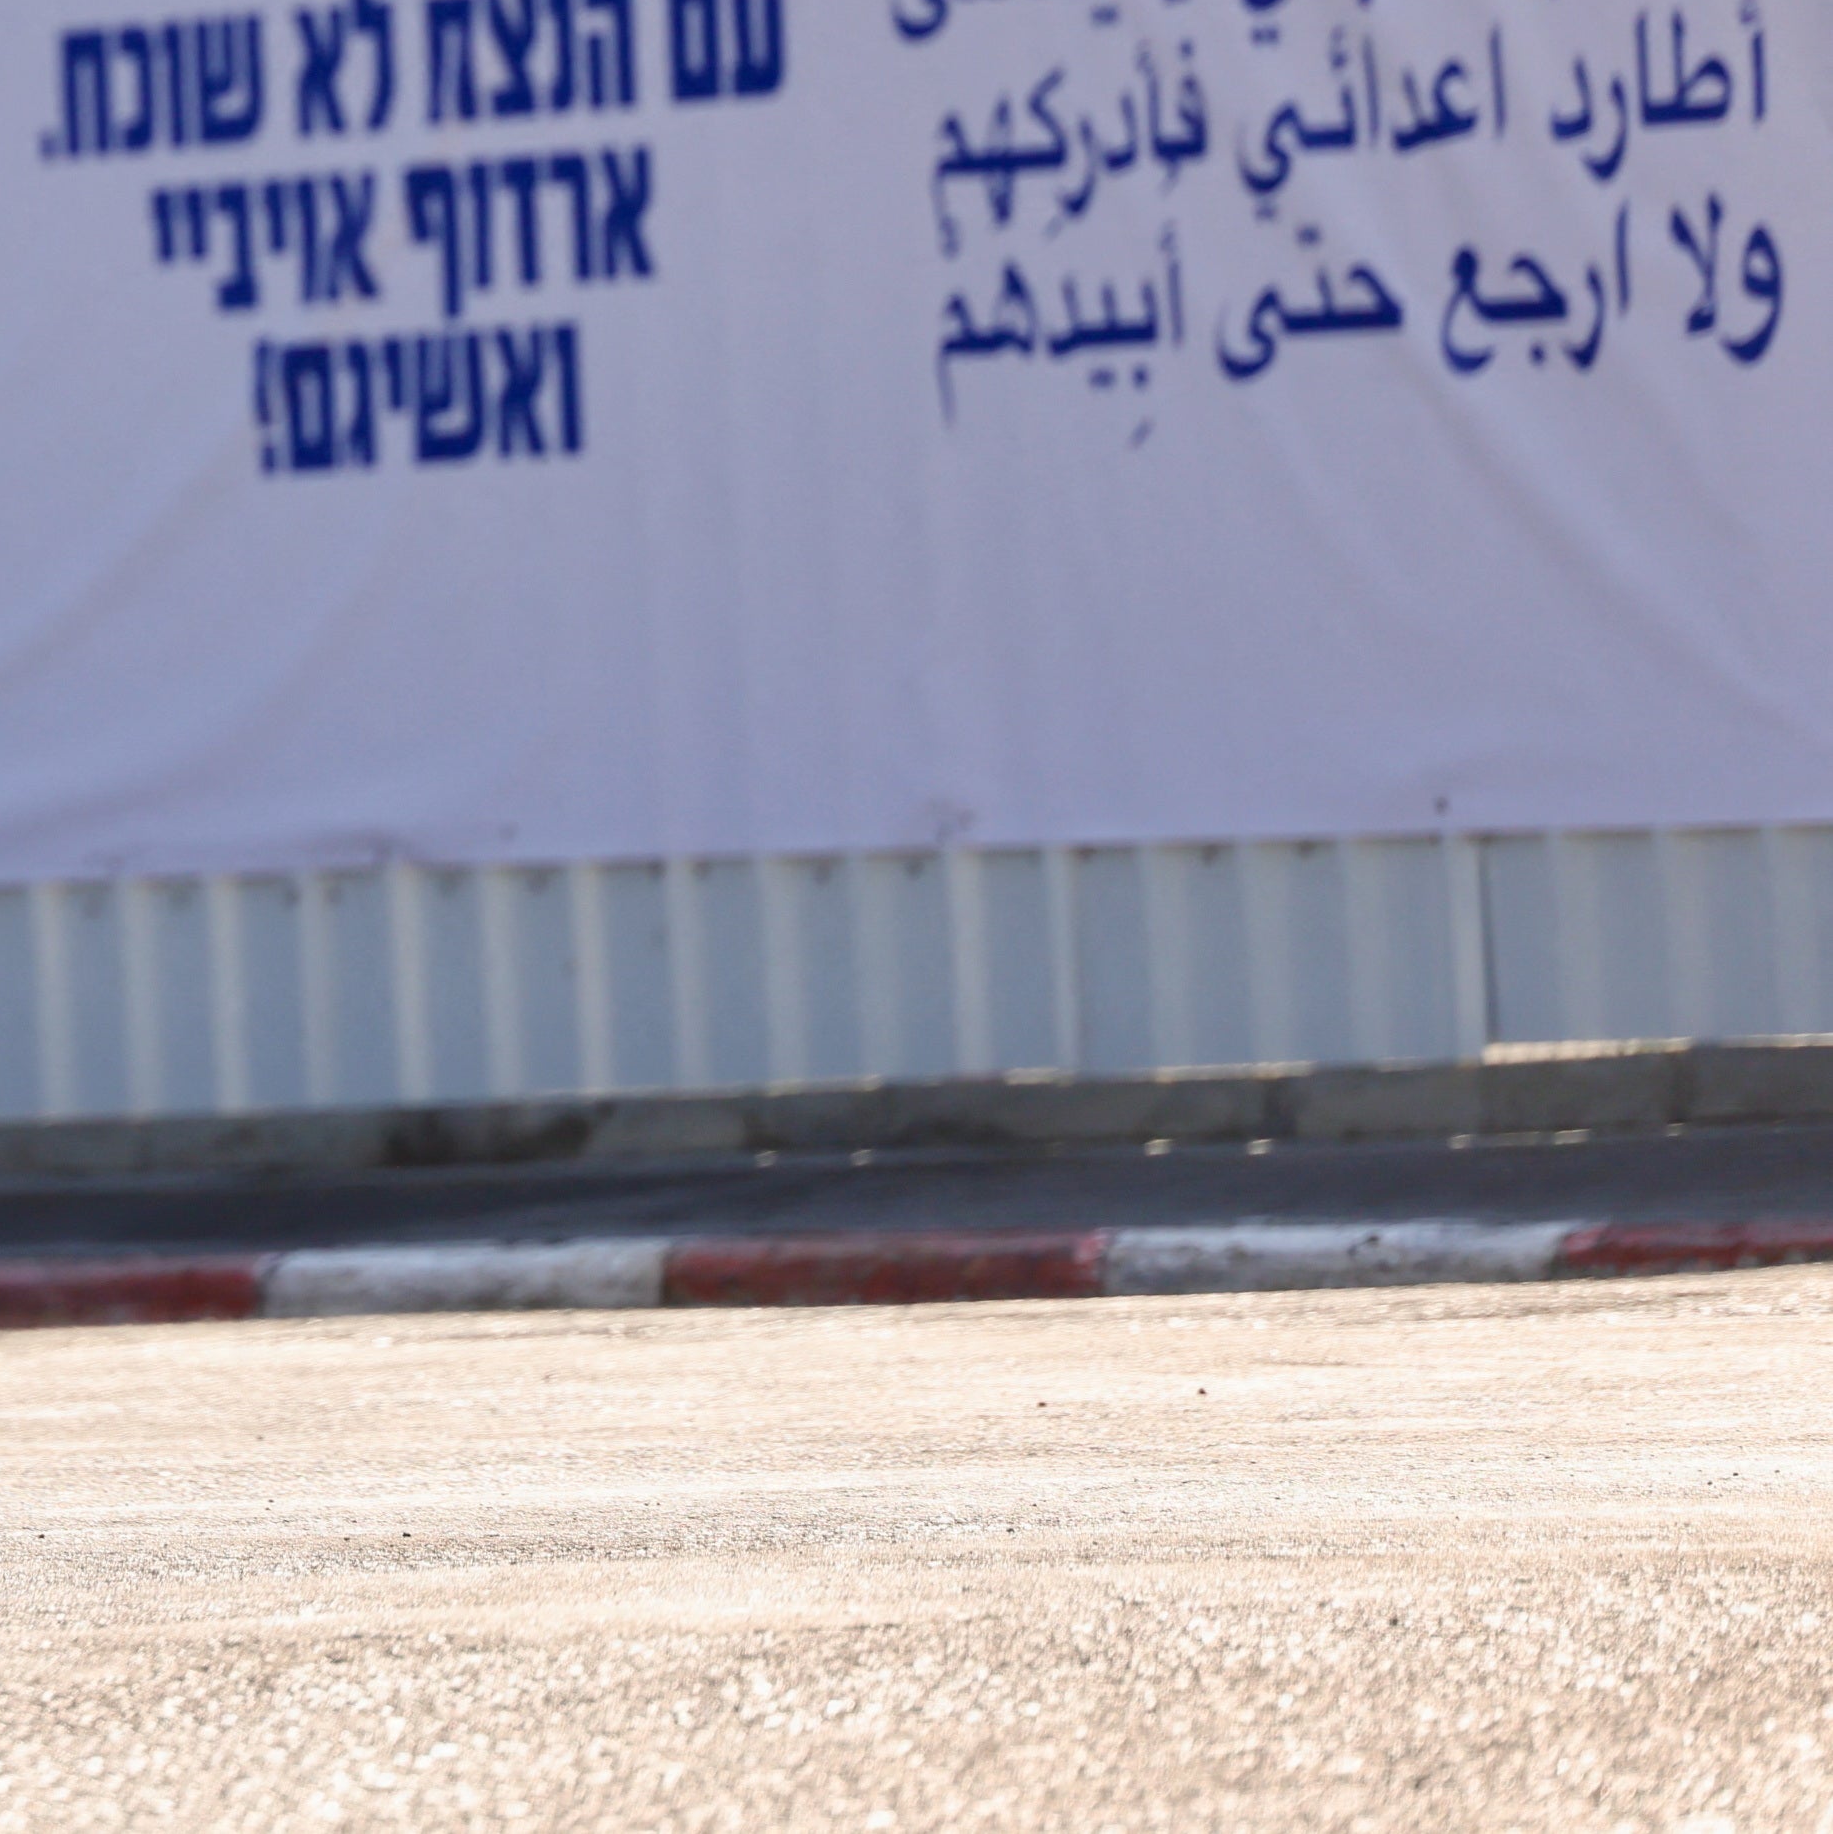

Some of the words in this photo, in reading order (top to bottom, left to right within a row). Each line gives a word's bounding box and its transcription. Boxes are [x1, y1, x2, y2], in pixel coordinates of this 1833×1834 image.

[402, 142, 659, 322] ארדוף
[1213, 221, 1406, 387] حتى
[1437, 197, 1634, 380] ارجع
[1667, 188, 1786, 370] ولا
[254, 317, 587, 475] ואשיגם!
